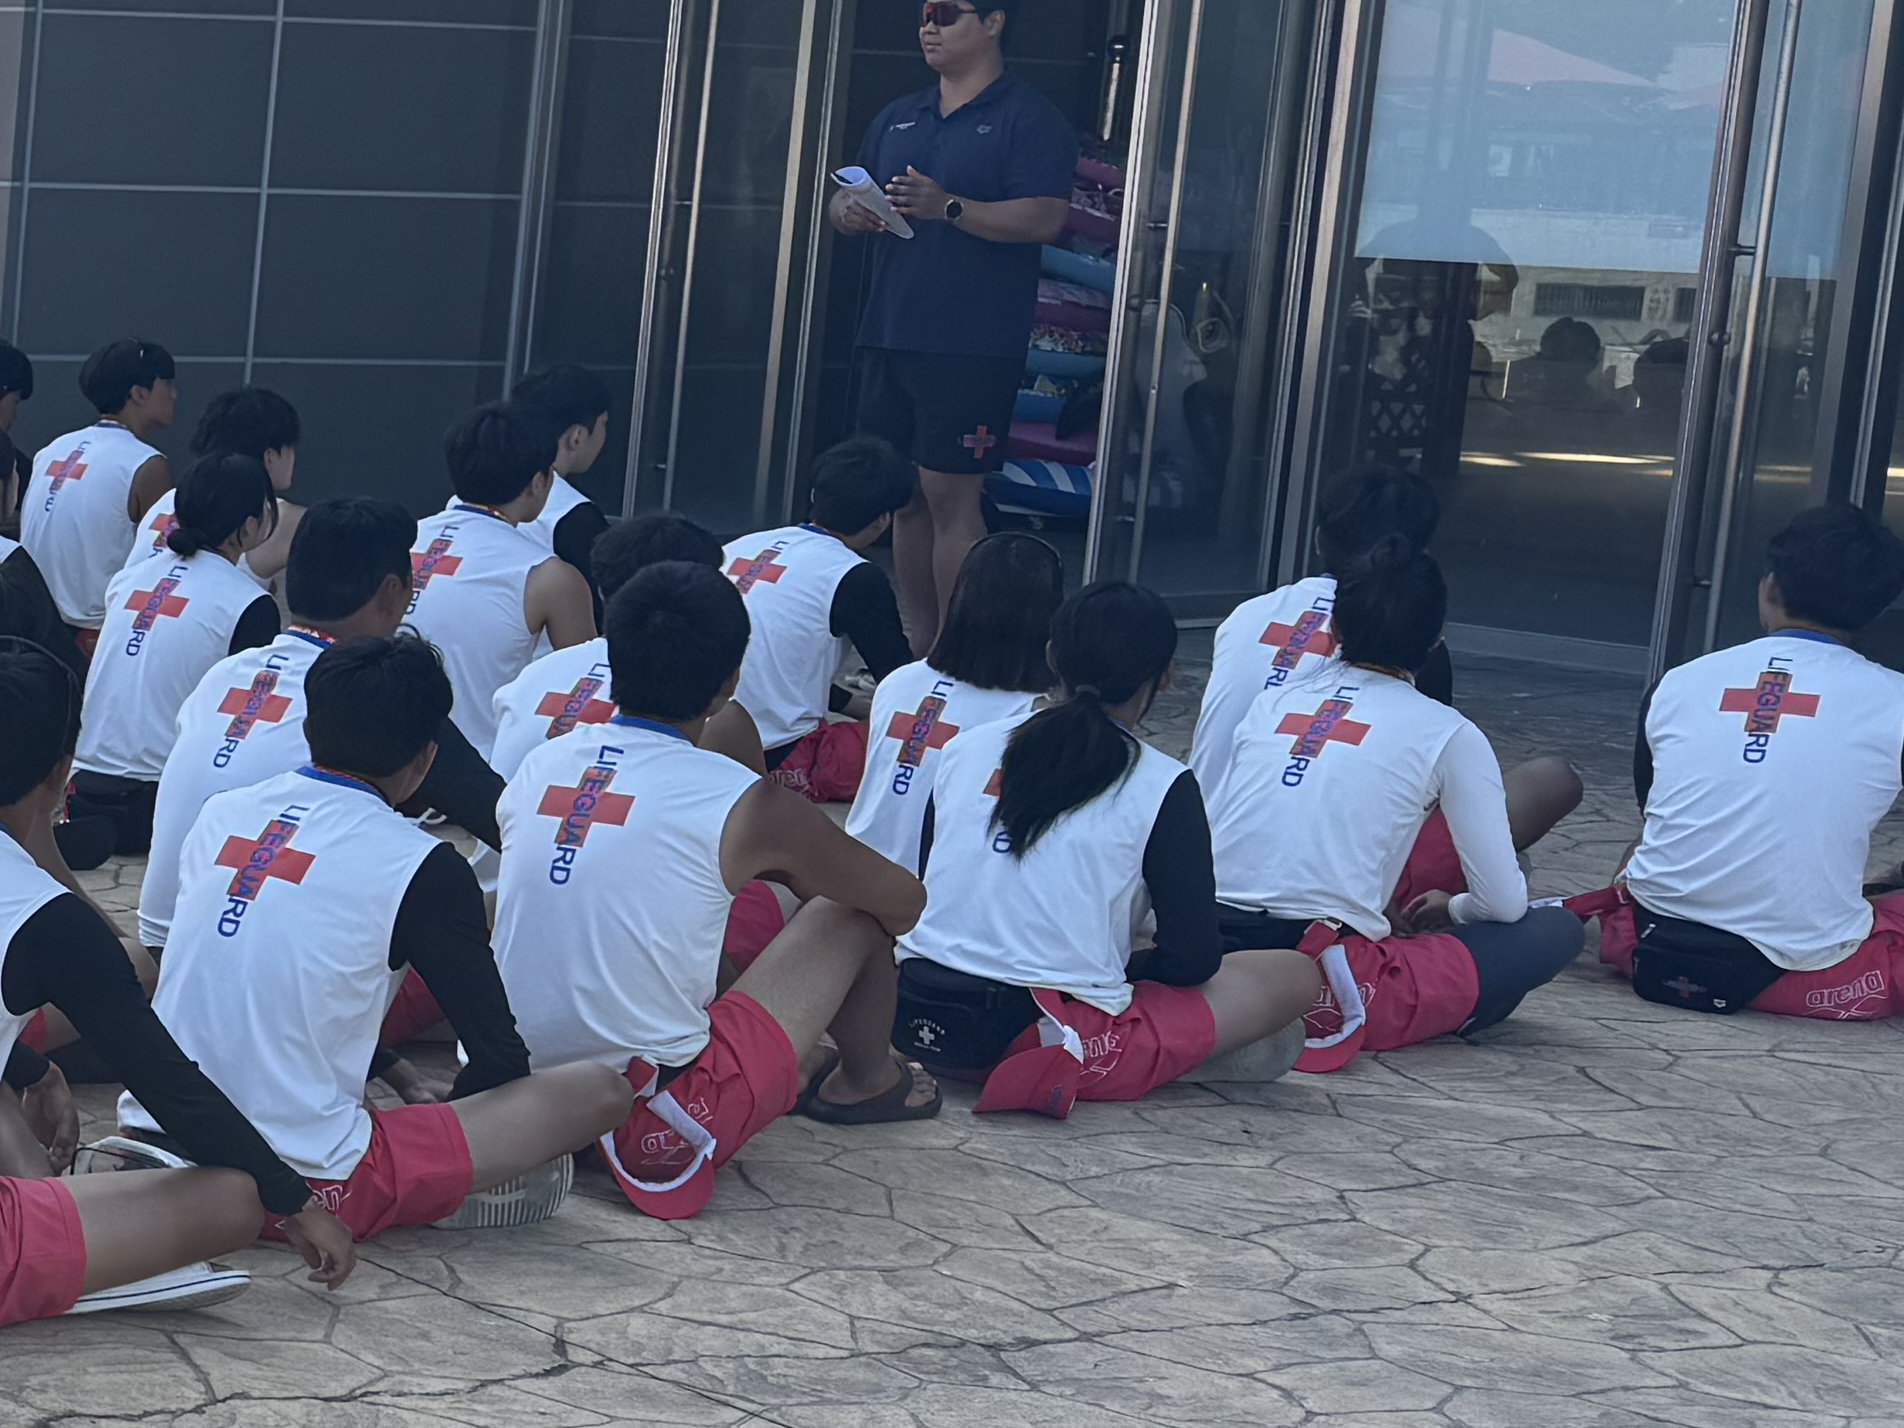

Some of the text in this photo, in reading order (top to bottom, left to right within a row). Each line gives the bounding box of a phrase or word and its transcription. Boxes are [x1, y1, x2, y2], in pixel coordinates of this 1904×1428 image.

[1281, 687, 1360, 788] LIFEGUARD
[1741, 657, 1795, 765] LIFEGUARD
[548, 745, 625, 886] LIFEGUARD
[217, 804, 311, 939] LIFEGUARD
[1805, 969, 1885, 1008] arena
